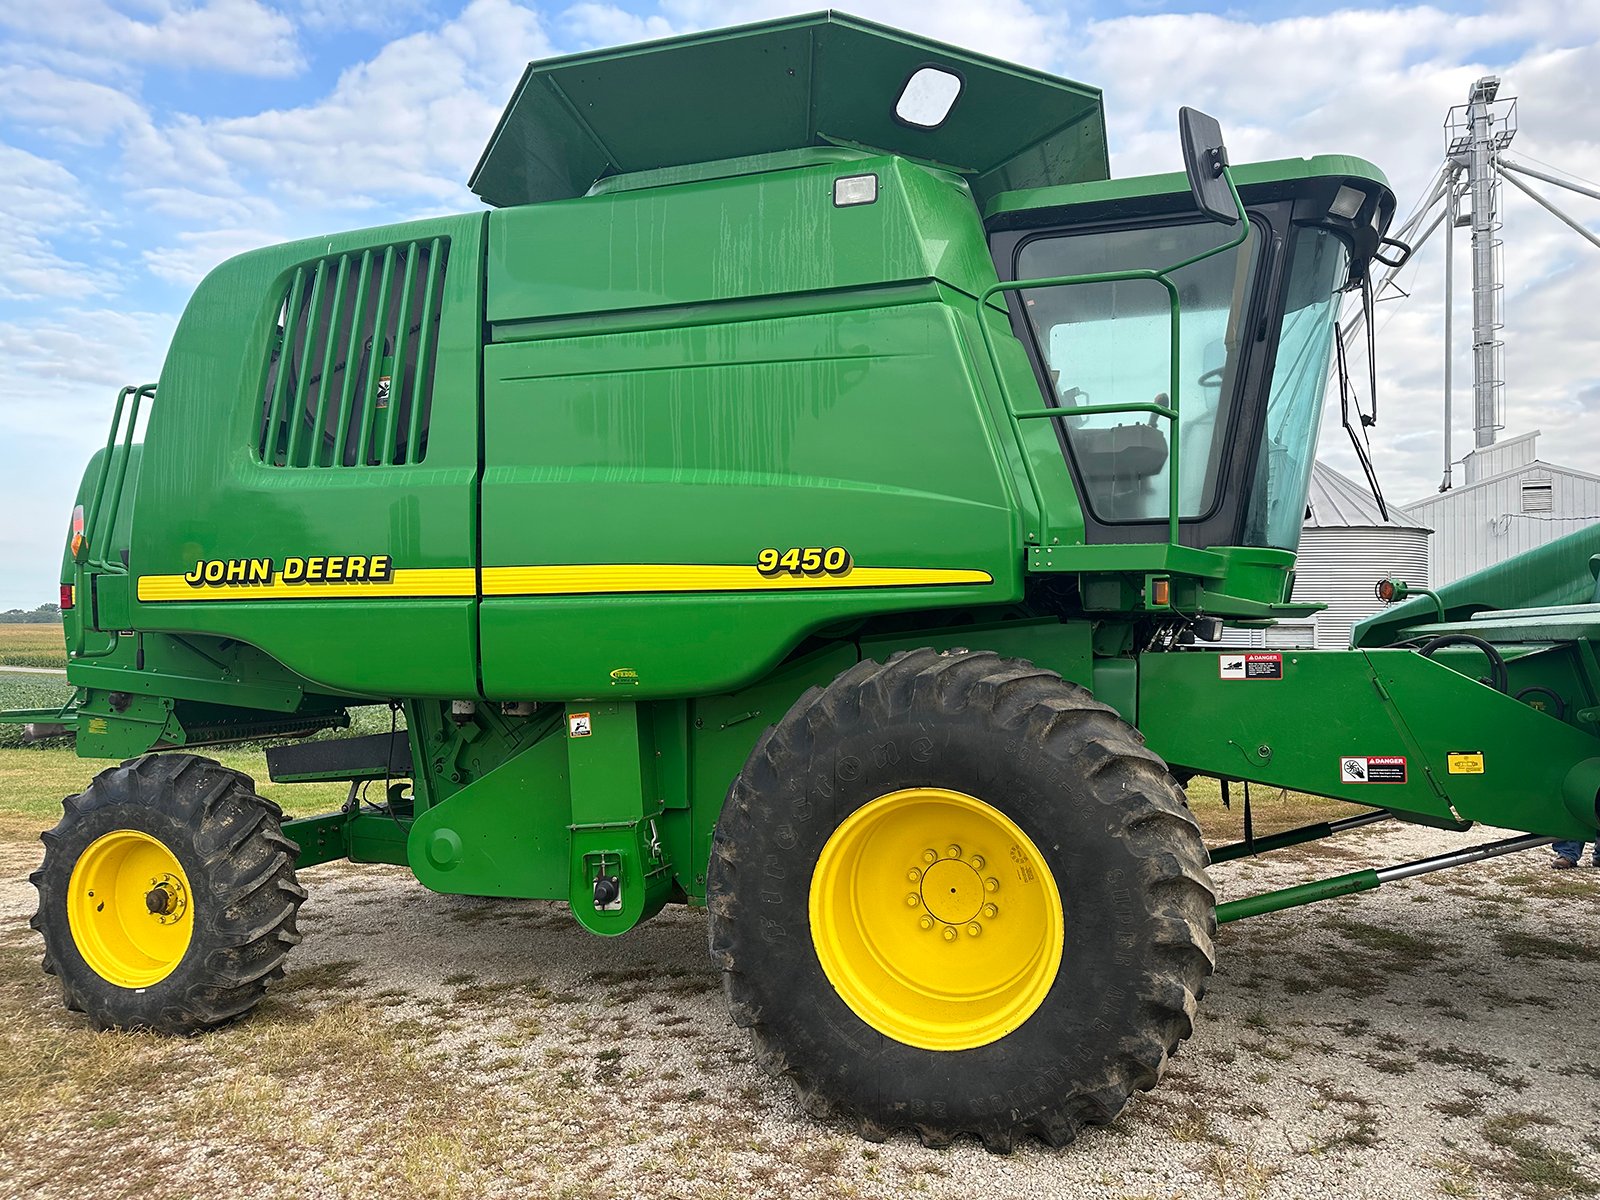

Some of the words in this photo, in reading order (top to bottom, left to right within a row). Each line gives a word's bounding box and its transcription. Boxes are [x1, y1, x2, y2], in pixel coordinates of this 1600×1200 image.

[184, 557, 274, 588] JOHN
[281, 554, 394, 586] DEERE
[757, 546, 853, 578] 9450
